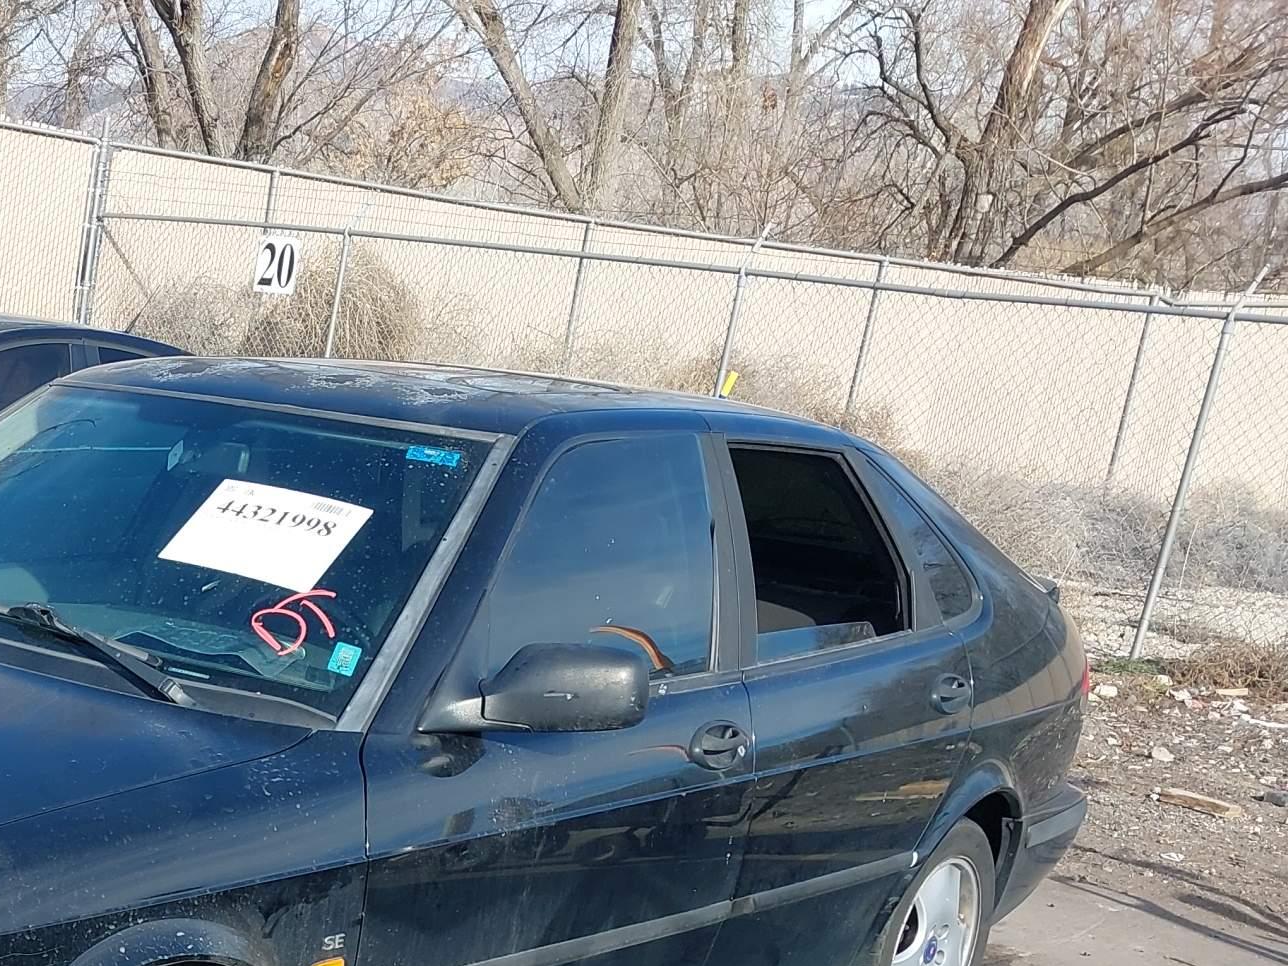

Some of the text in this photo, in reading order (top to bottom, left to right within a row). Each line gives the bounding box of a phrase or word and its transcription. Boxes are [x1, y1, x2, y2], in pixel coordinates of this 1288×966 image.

[257, 243, 295, 288] 20
[216, 500, 337, 537] 44321998
[322, 933, 346, 950] SE
